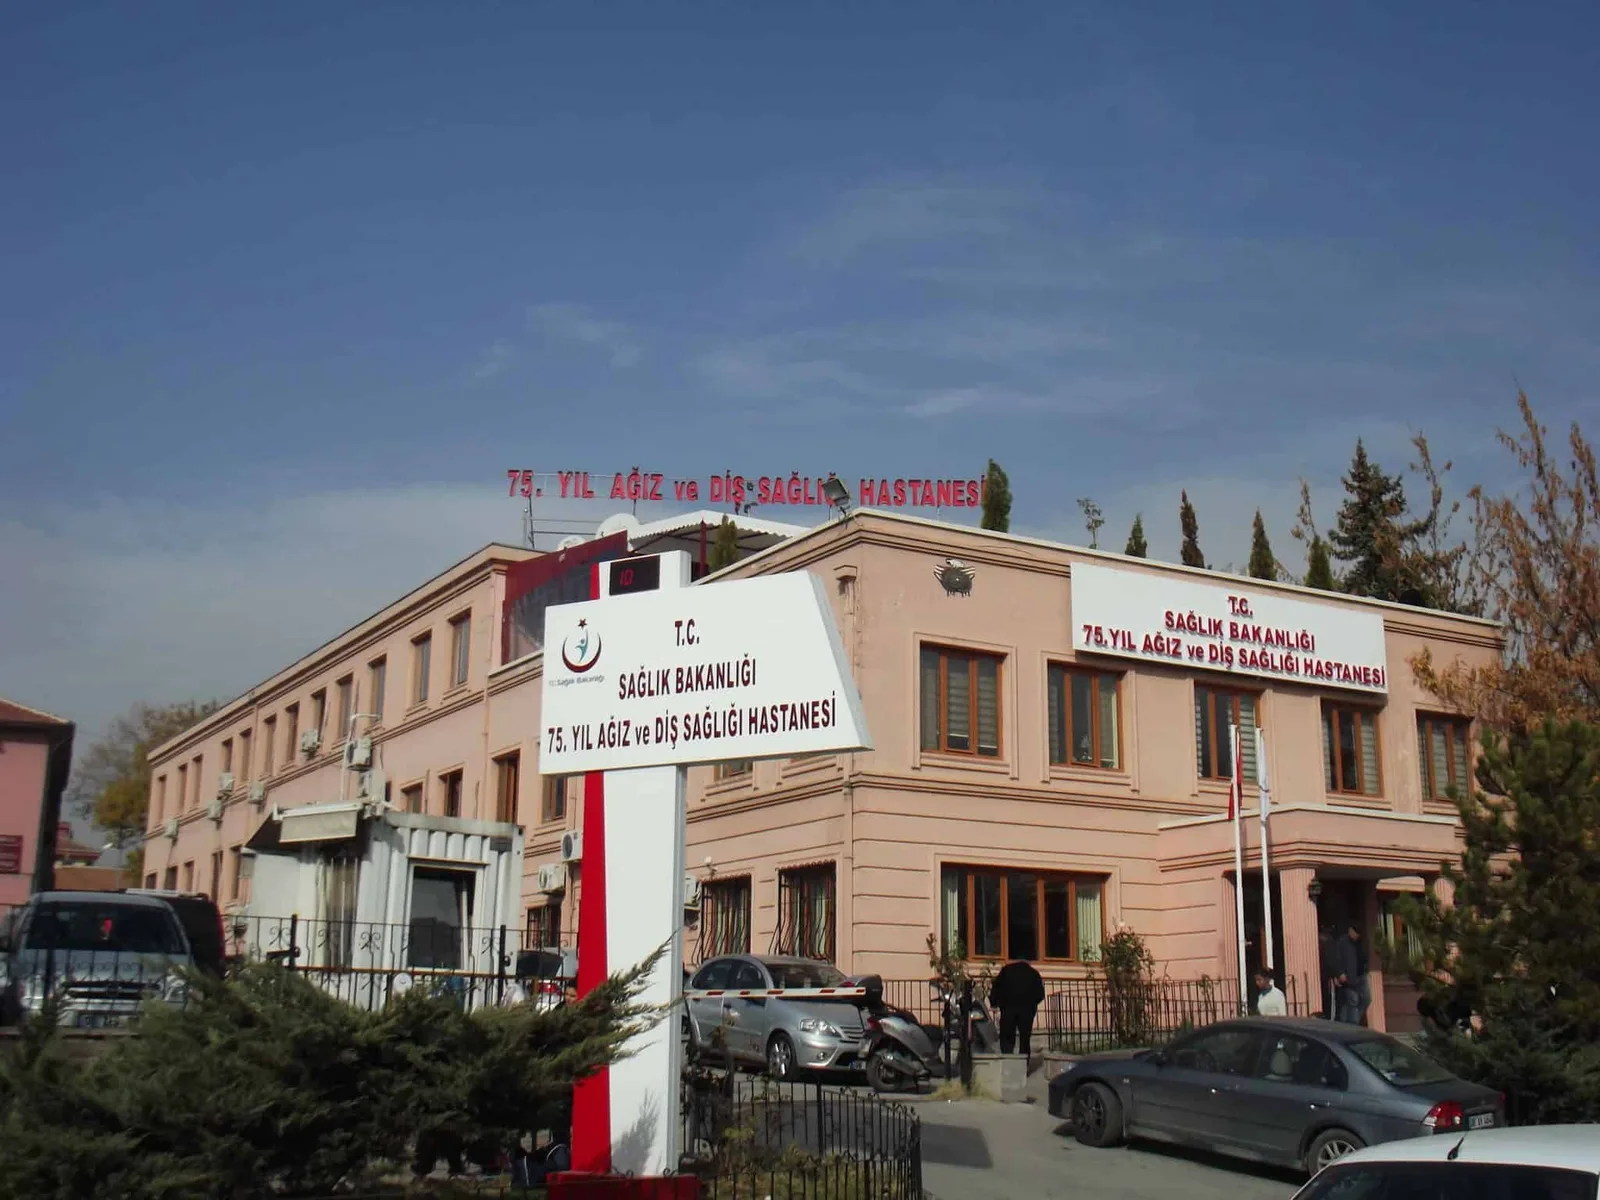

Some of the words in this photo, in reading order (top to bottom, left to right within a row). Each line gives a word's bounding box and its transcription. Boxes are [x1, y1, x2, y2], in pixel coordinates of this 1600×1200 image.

[508, 470, 541, 497] 75.
[557, 471, 594, 498] YIL
[610, 466, 663, 500] AĞIZ
[674, 481, 698, 501] ve
[711, 470, 745, 515] DİŞ
[1165, 610, 1224, 637] SAĞLIK
[1229, 621, 1315, 651] BAKANLIĞI
[1228, 596, 1253, 617] T.C.
[674, 618, 700, 646] T.C.
[619, 665, 670, 700] SAĞLIK
[675, 652, 756, 694] BAKANLIĞI
[1142, 632, 1182, 656] AĞIZ
[1187, 645, 1204, 658] ve
[1209, 641, 1234, 668] DİŞ
[1239, 647, 1299, 674] SAĞLIĞI
[1303, 656, 1385, 686] HASTANESİ
[548, 727, 567, 753] 75.
[572, 724, 593, 751] YIL
[597, 716, 631, 749] AĞIZ
[635, 724, 650, 745] ve
[655, 709, 678, 750] DİŞ
[683, 701, 743, 741] SAĞLIĞI
[748, 690, 836, 736] HASTANESİ
